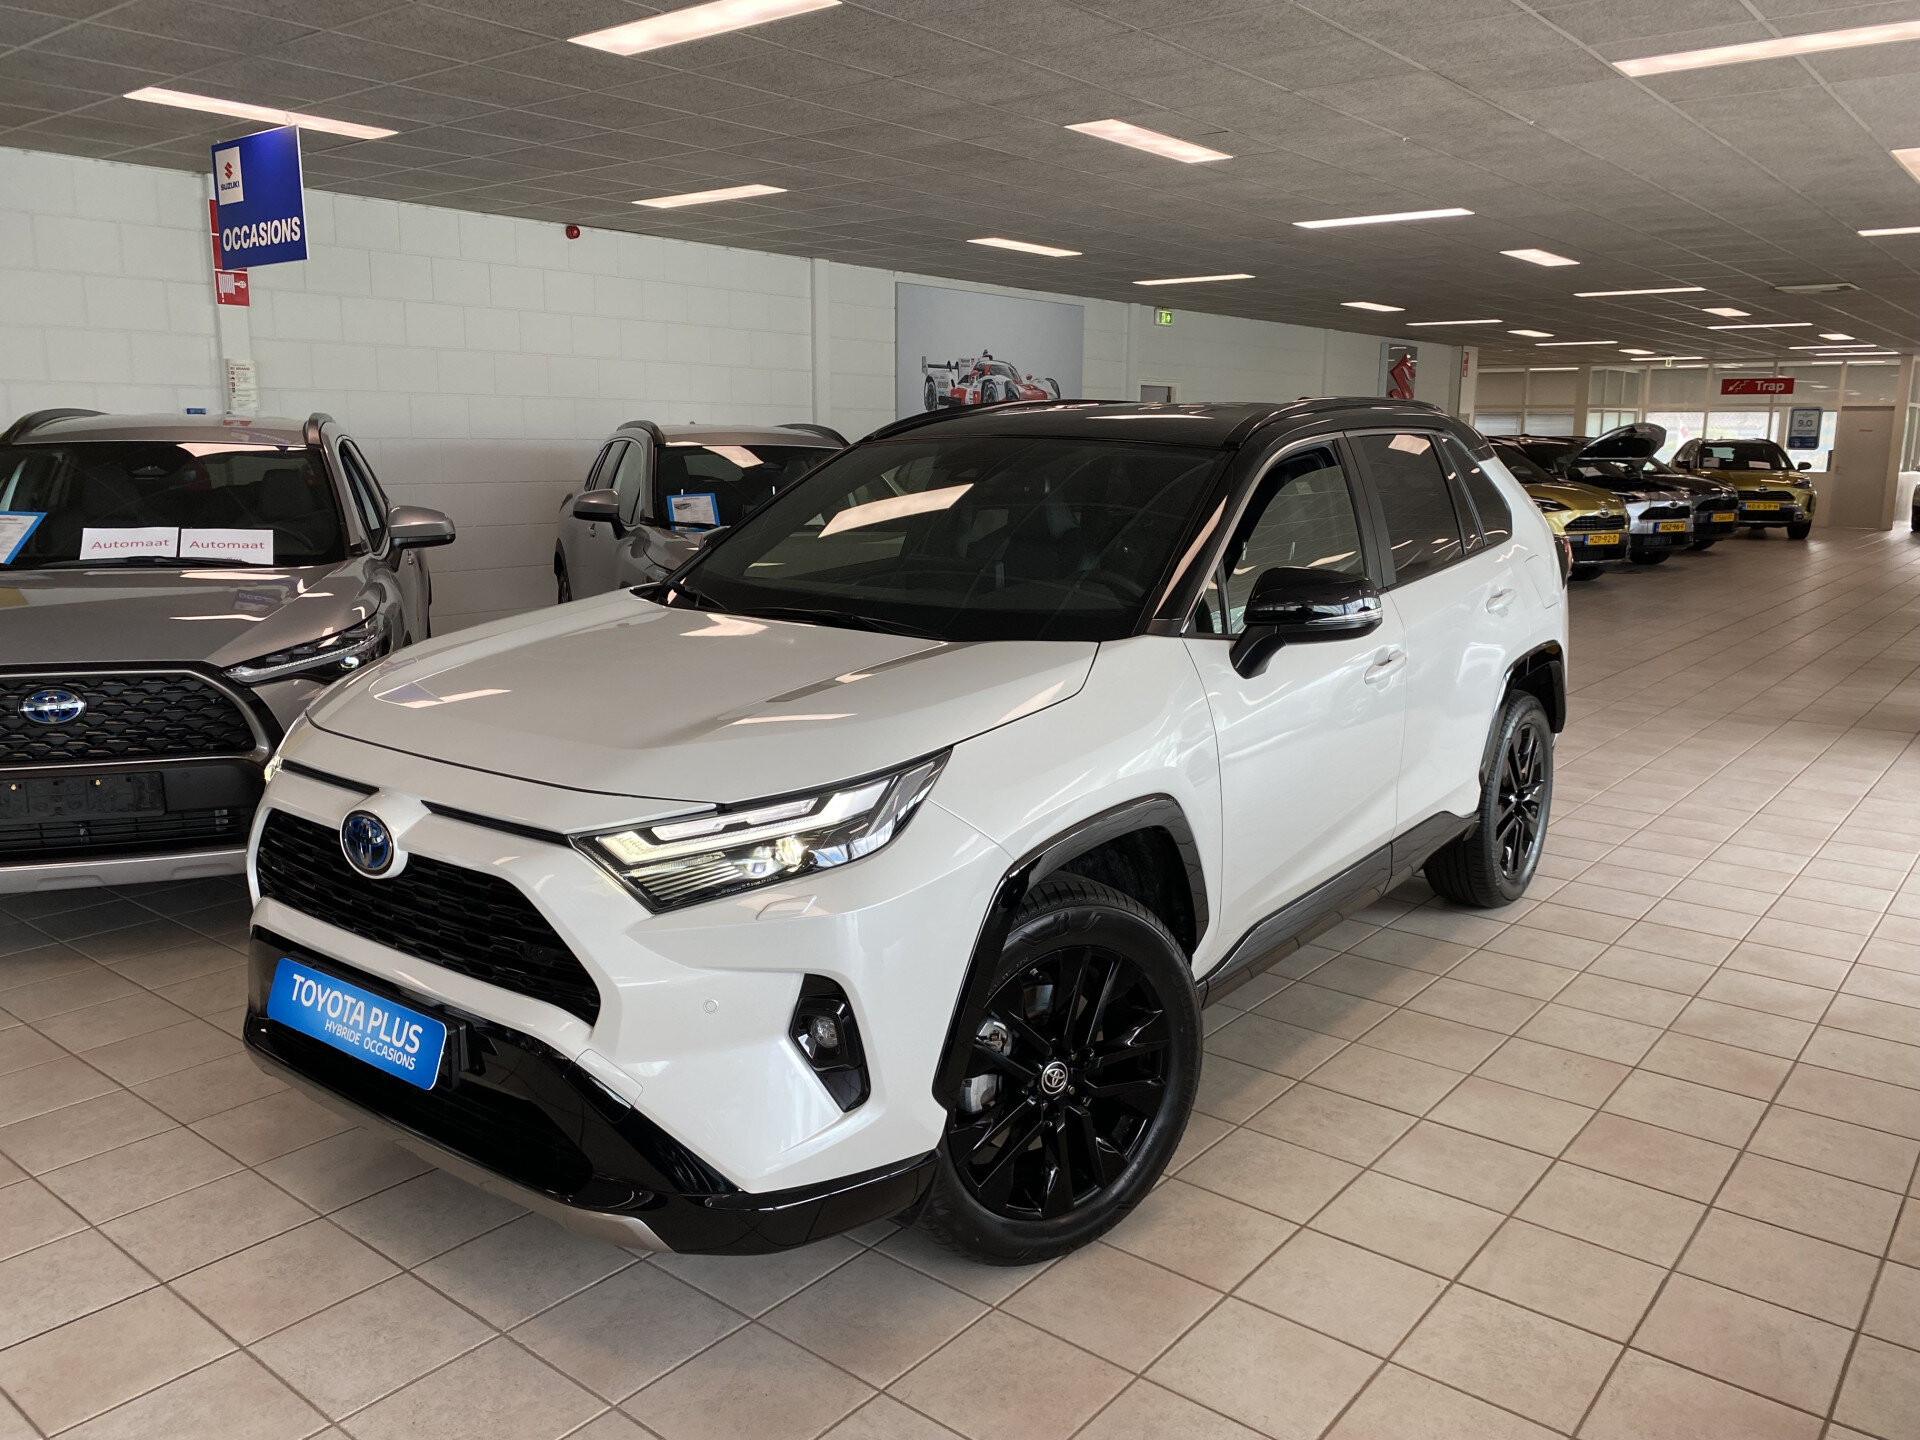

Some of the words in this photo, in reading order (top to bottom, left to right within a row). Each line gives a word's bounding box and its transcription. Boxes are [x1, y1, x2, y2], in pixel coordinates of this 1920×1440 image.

[221, 181, 240, 191] SUZUKI
[223, 216, 300, 251] OCCASIONS
[1755, 381, 1785, 393] Trap
[91, 539, 170, 549] Automaat
[189, 540, 265, 549] Automaat
[292, 974, 365, 1030] TOYOTA
[367, 1006, 423, 1054] PLUS
[324, 1019, 362, 1046] HYBRIDE
[363, 1038, 416, 1071] OCCASIONS
